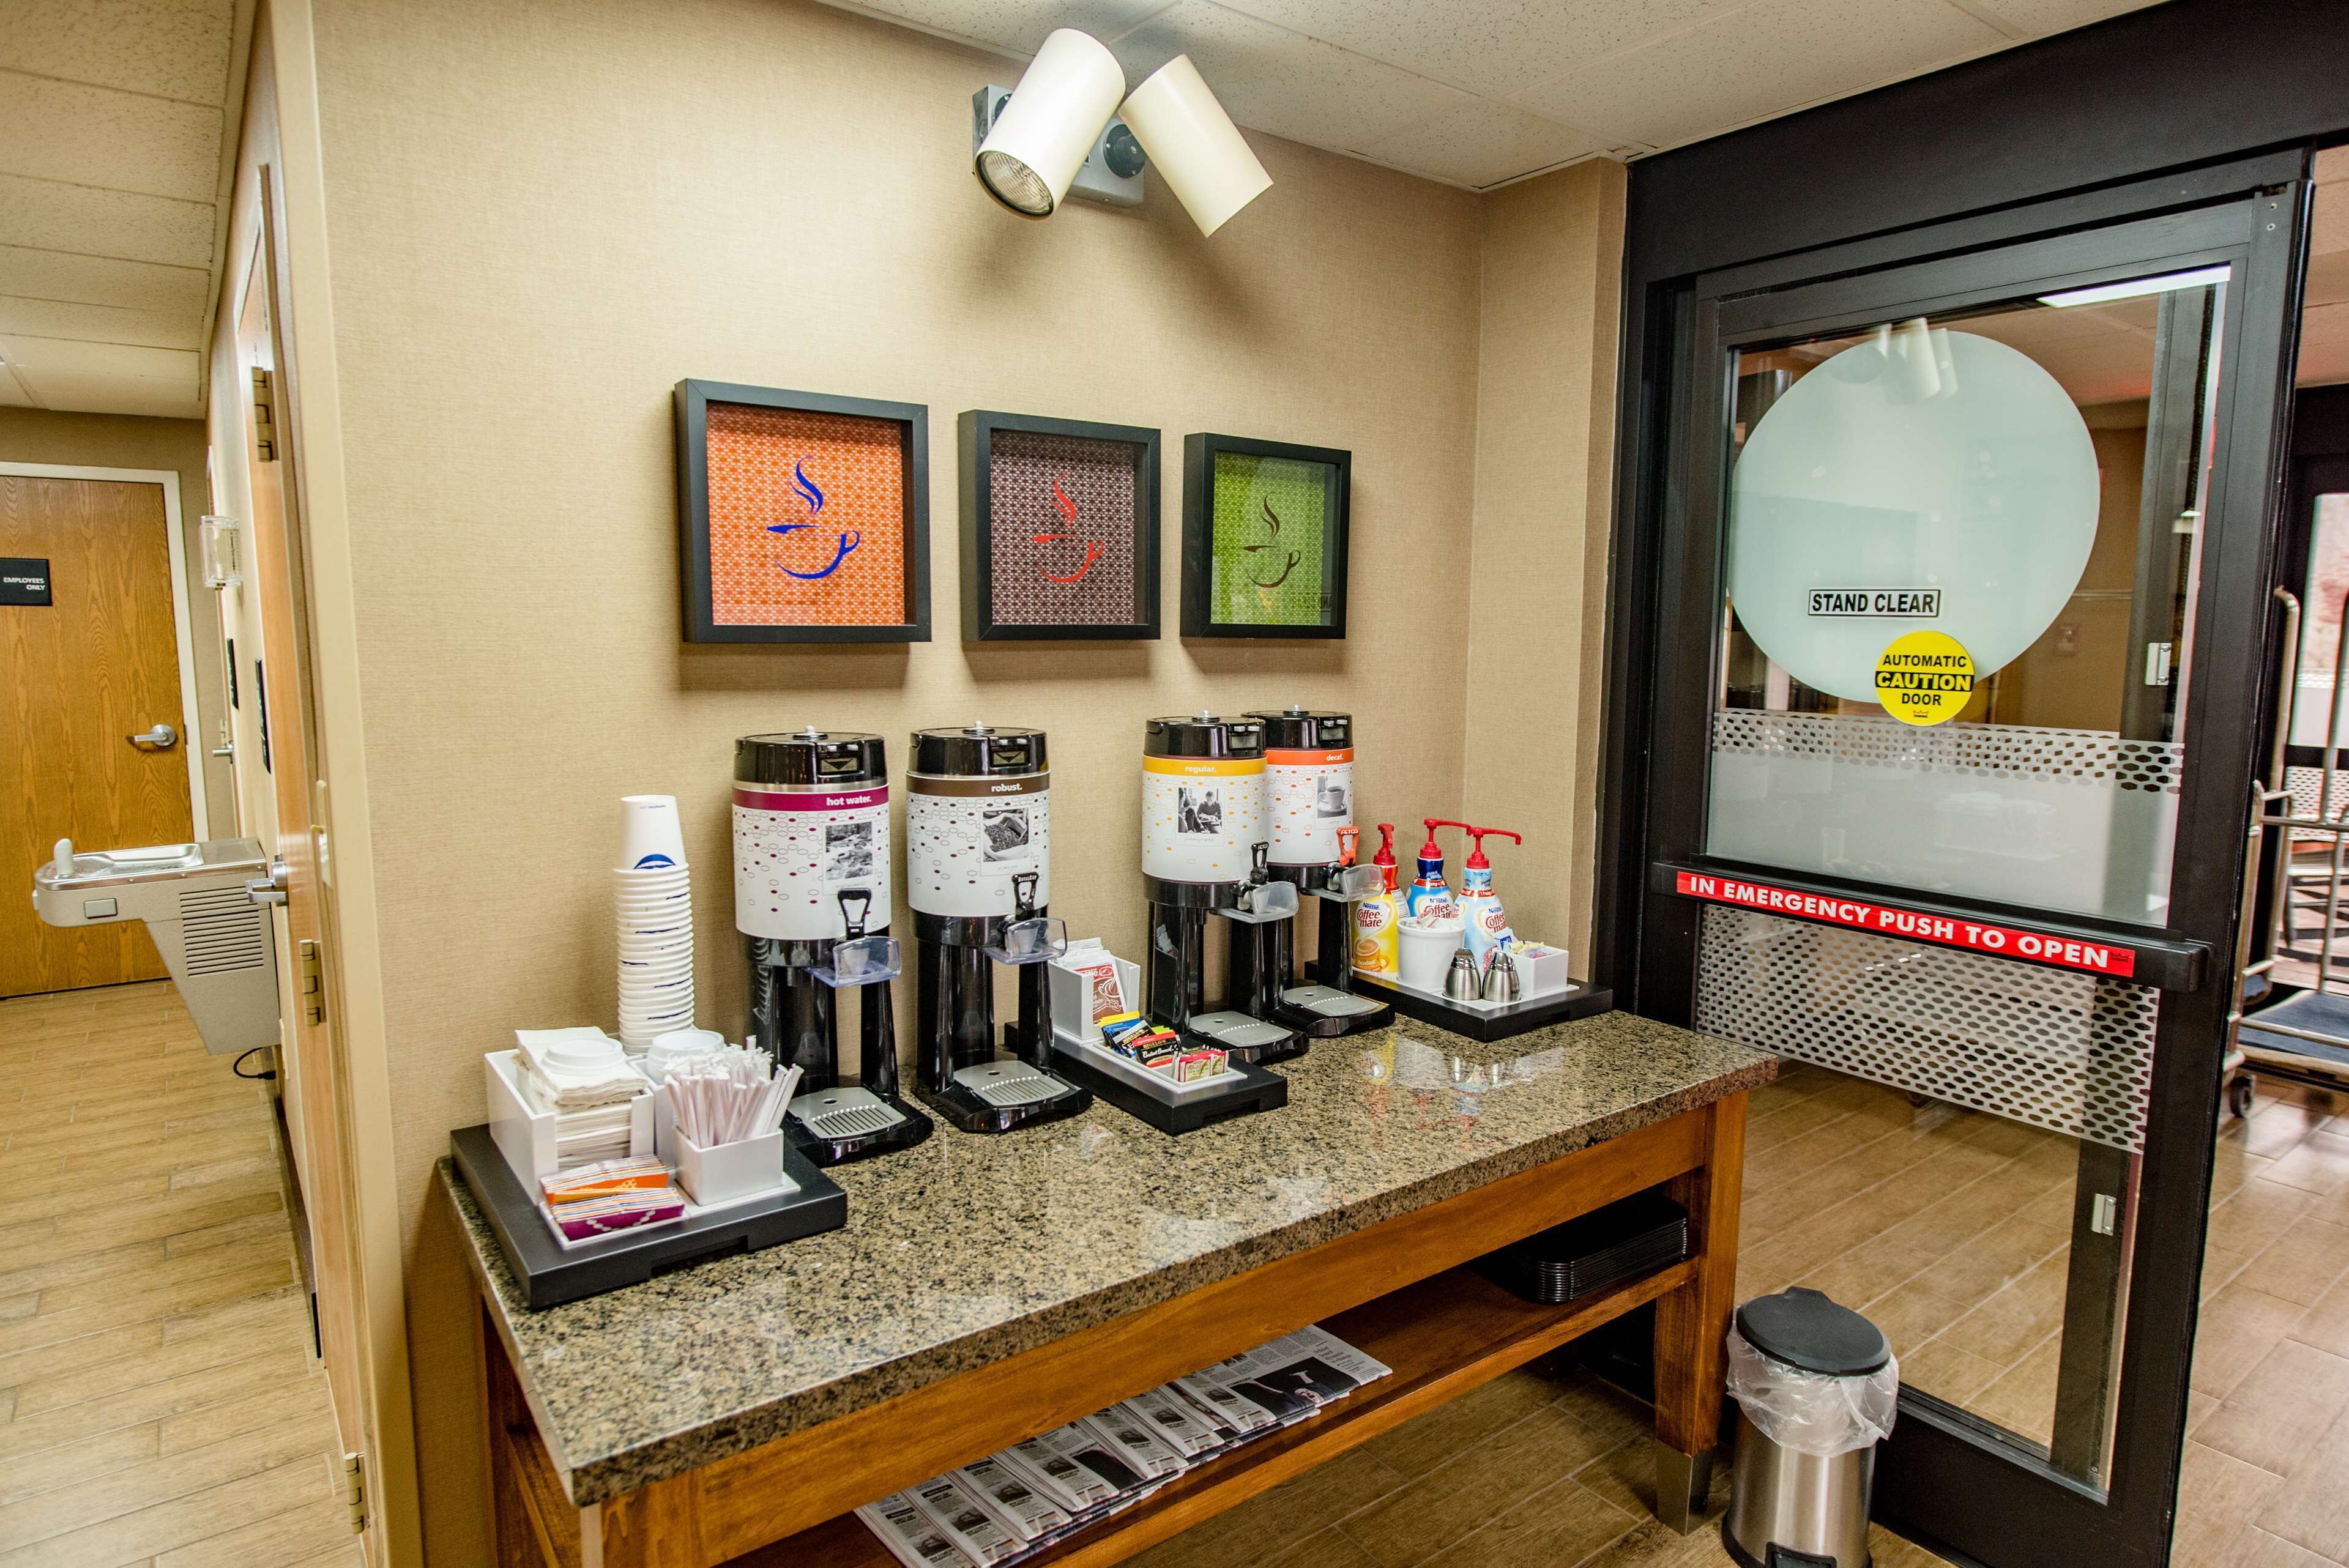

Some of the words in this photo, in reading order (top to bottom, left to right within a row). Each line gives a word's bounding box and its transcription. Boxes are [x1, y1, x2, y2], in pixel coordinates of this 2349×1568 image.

[1812, 593, 1868, 612] STAND
[1875, 593, 1934, 612] CLEAR
[1883, 655, 1967, 667] AUTOMATIC
[1877, 672, 1971, 691] CAUTION
[1902, 693, 1941, 705] DOOR
[991, 783, 1022, 792] robust.
[826, 797, 844, 806] hot
[846, 795, 871, 804] water.
[1360, 919, 1382, 927] mate
[1691, 877, 1714, 894] IN
[1724, 882, 1871, 923] EMERGENCY
[1879, 911, 1954, 940] PUSH
[1965, 926, 2006, 948] TO
[2019, 936, 2109, 968] OPEN
